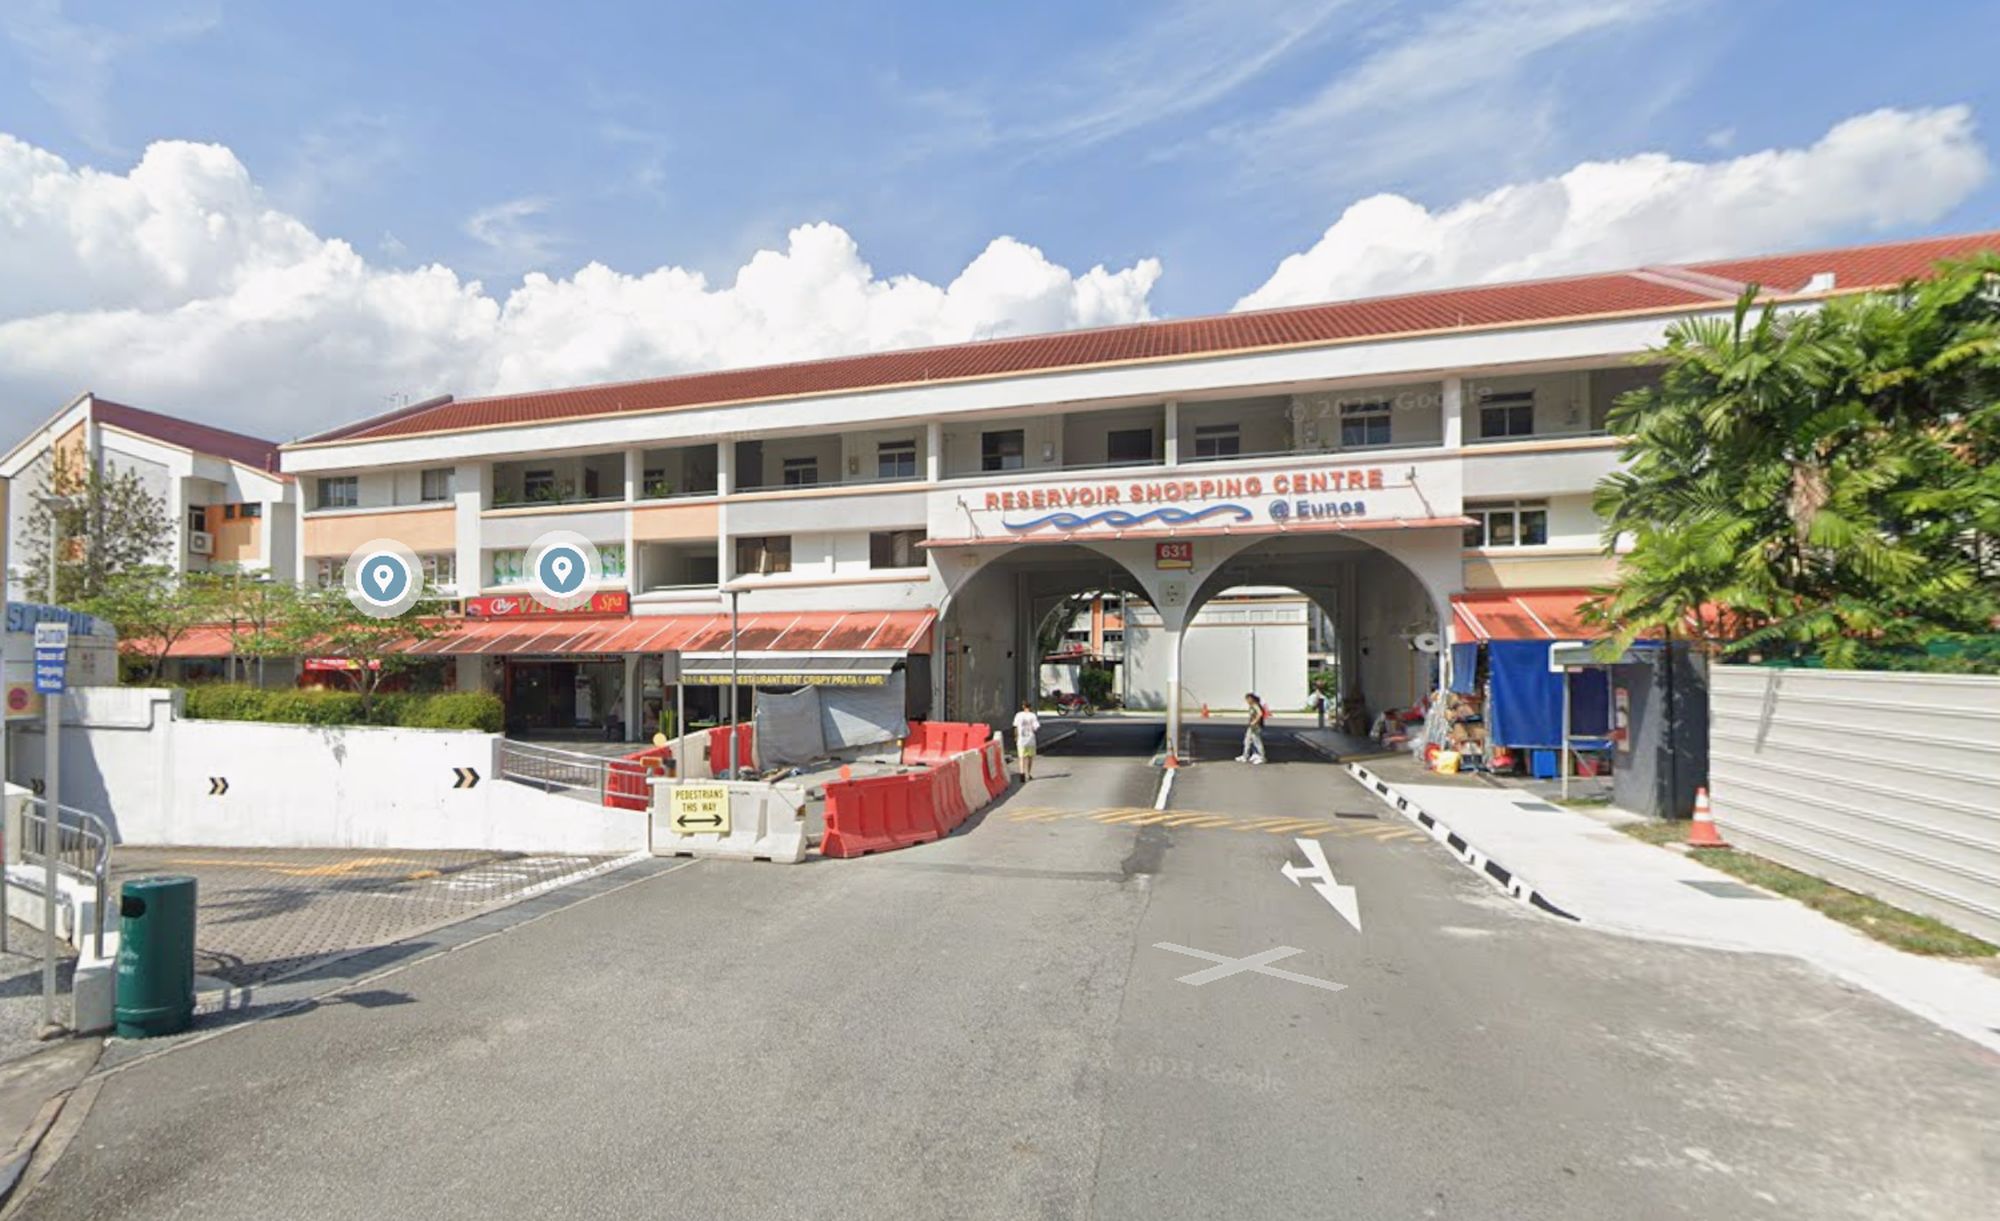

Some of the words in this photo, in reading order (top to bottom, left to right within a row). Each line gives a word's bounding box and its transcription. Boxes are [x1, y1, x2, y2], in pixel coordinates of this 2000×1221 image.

[984, 486, 1121, 512] RESERVOIR
[1129, 476, 1263, 505] SHOPPING
[1273, 468, 1384, 495] CENTRE
[1296, 498, 1367, 519] Eunos
[1161, 544, 1188, 559] 631
[675, 789, 724, 801] PEDESTRIANS
[682, 802, 698, 813] THIS
[702, 802, 717, 812] WAY
